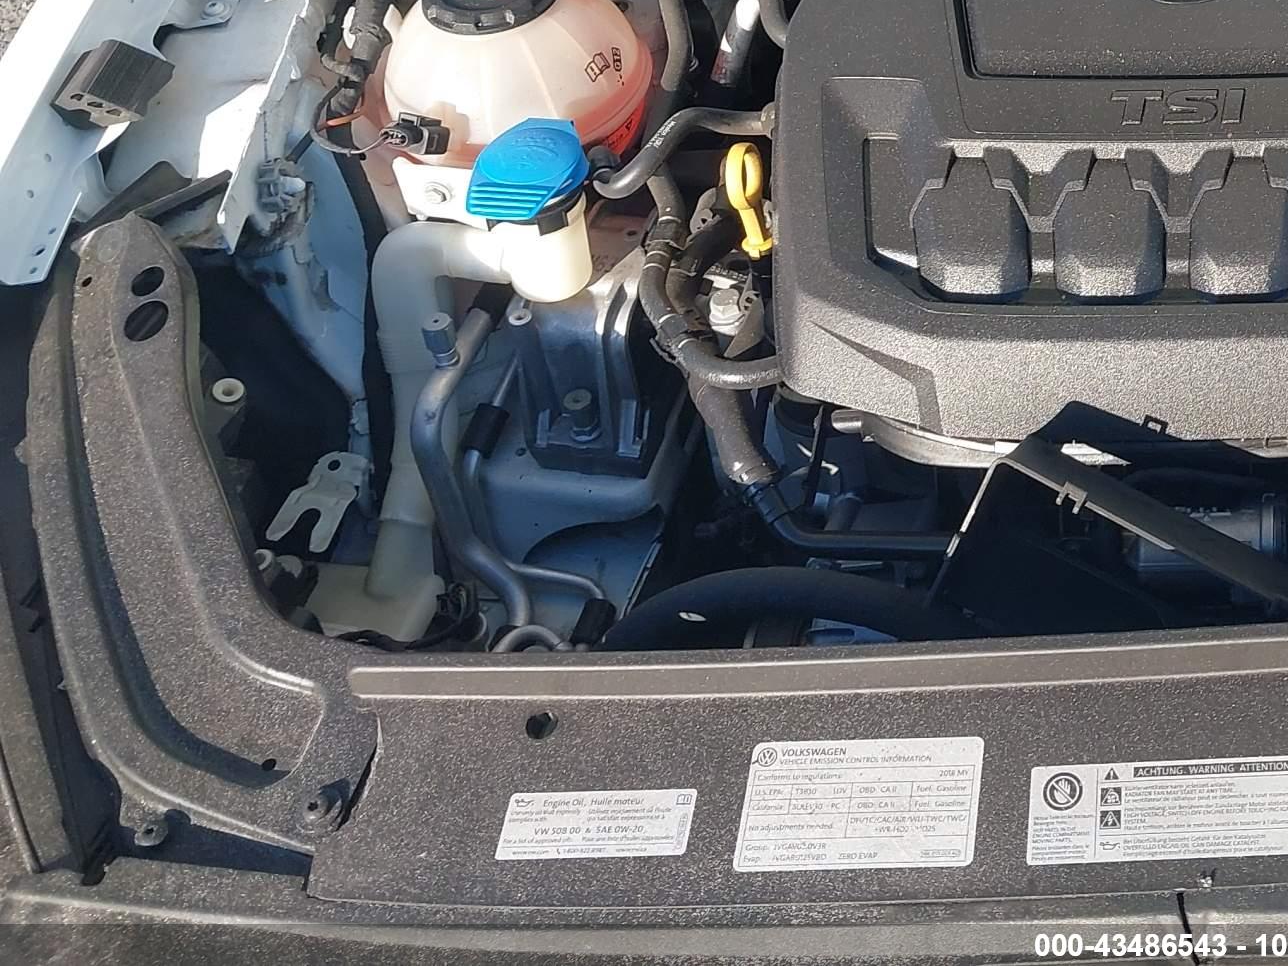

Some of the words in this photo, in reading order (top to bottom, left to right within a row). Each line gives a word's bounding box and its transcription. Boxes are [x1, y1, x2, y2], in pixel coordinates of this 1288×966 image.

[1110, 87, 1246, 125] TSI
[781, 747, 847, 757] VOLKSWAGEN
[780, 757, 808, 765] VEHICLE
[880, 754, 932, 763] INFORMATION
[1188, 764, 1235, 774] WARNING
[543, 799, 570, 809] Engine
[534, 827, 550, 835] VW
[569, 826, 581, 835] 00
[596, 826, 612, 834] SAE
